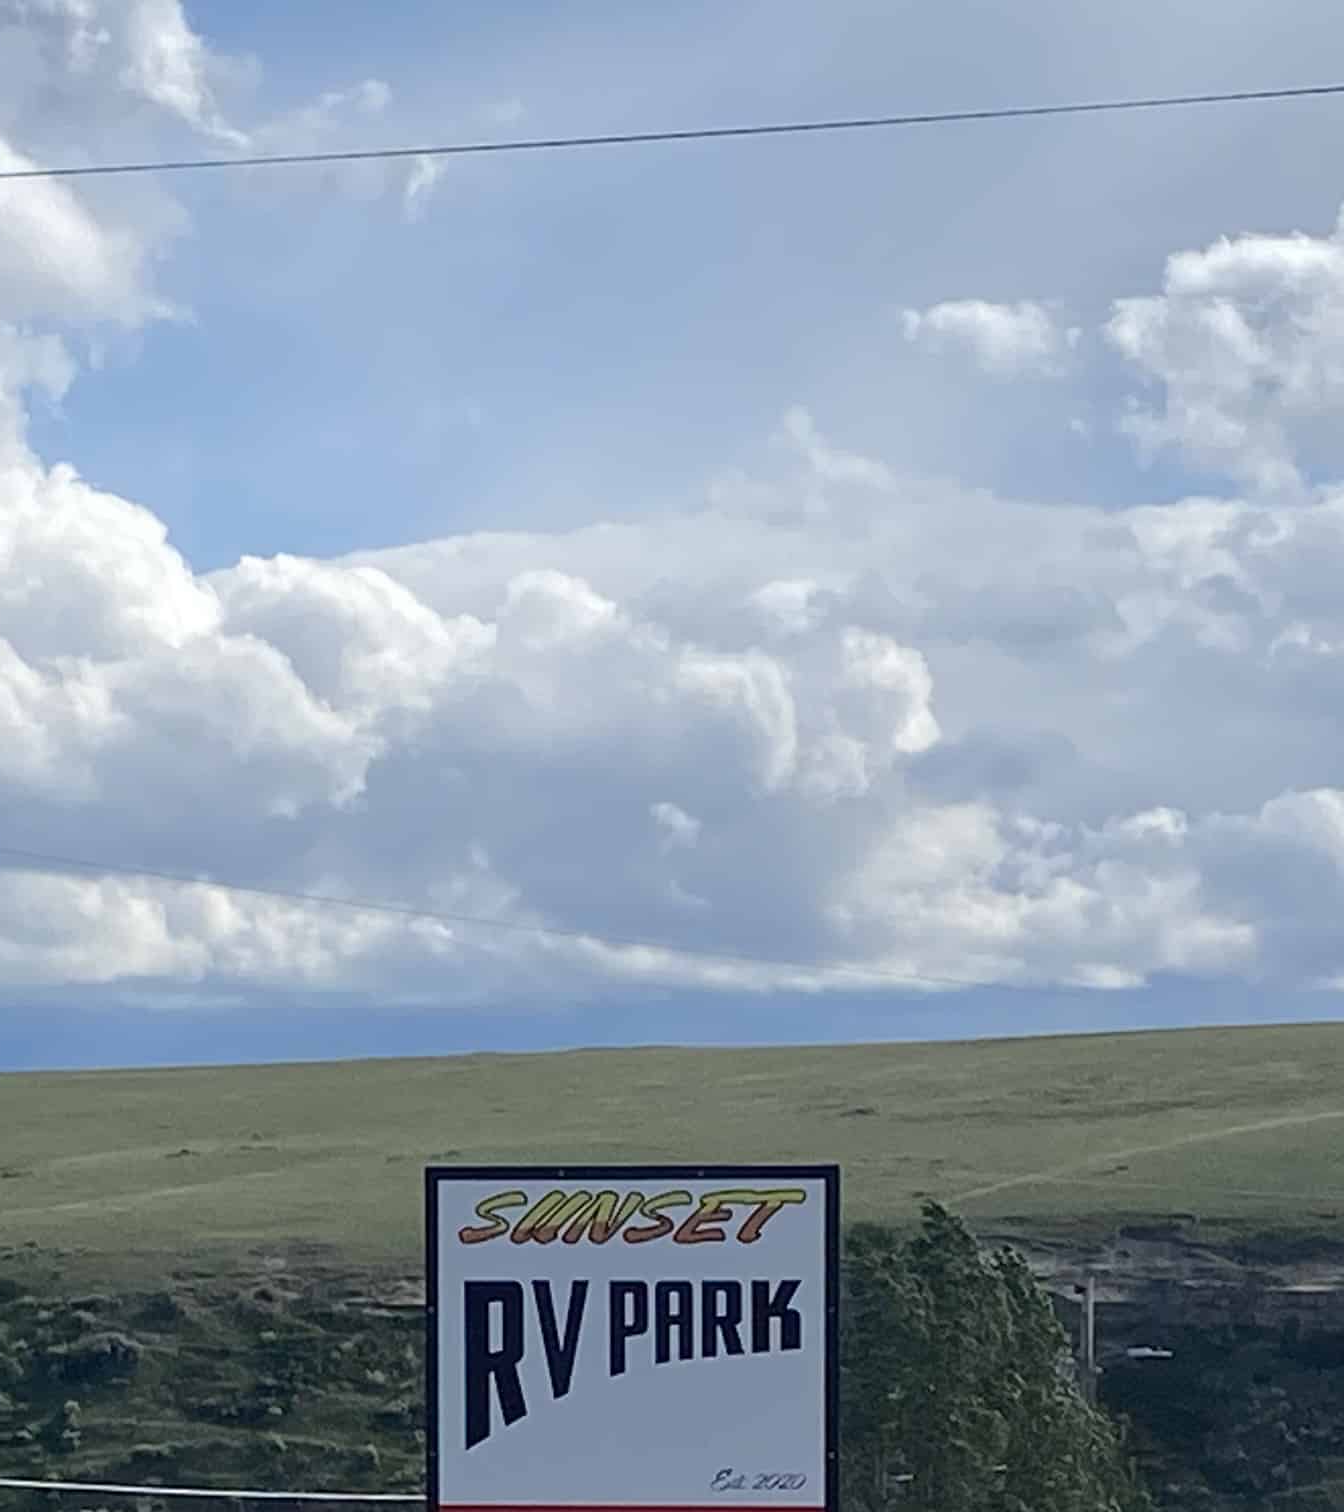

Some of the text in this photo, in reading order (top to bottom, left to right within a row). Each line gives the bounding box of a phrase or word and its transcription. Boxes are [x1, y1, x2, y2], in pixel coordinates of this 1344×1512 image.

[458, 1189, 807, 1244] SUNSET
[464, 1280, 803, 1450] RV PARK
[752, 1473, 807, 1491] 2020
